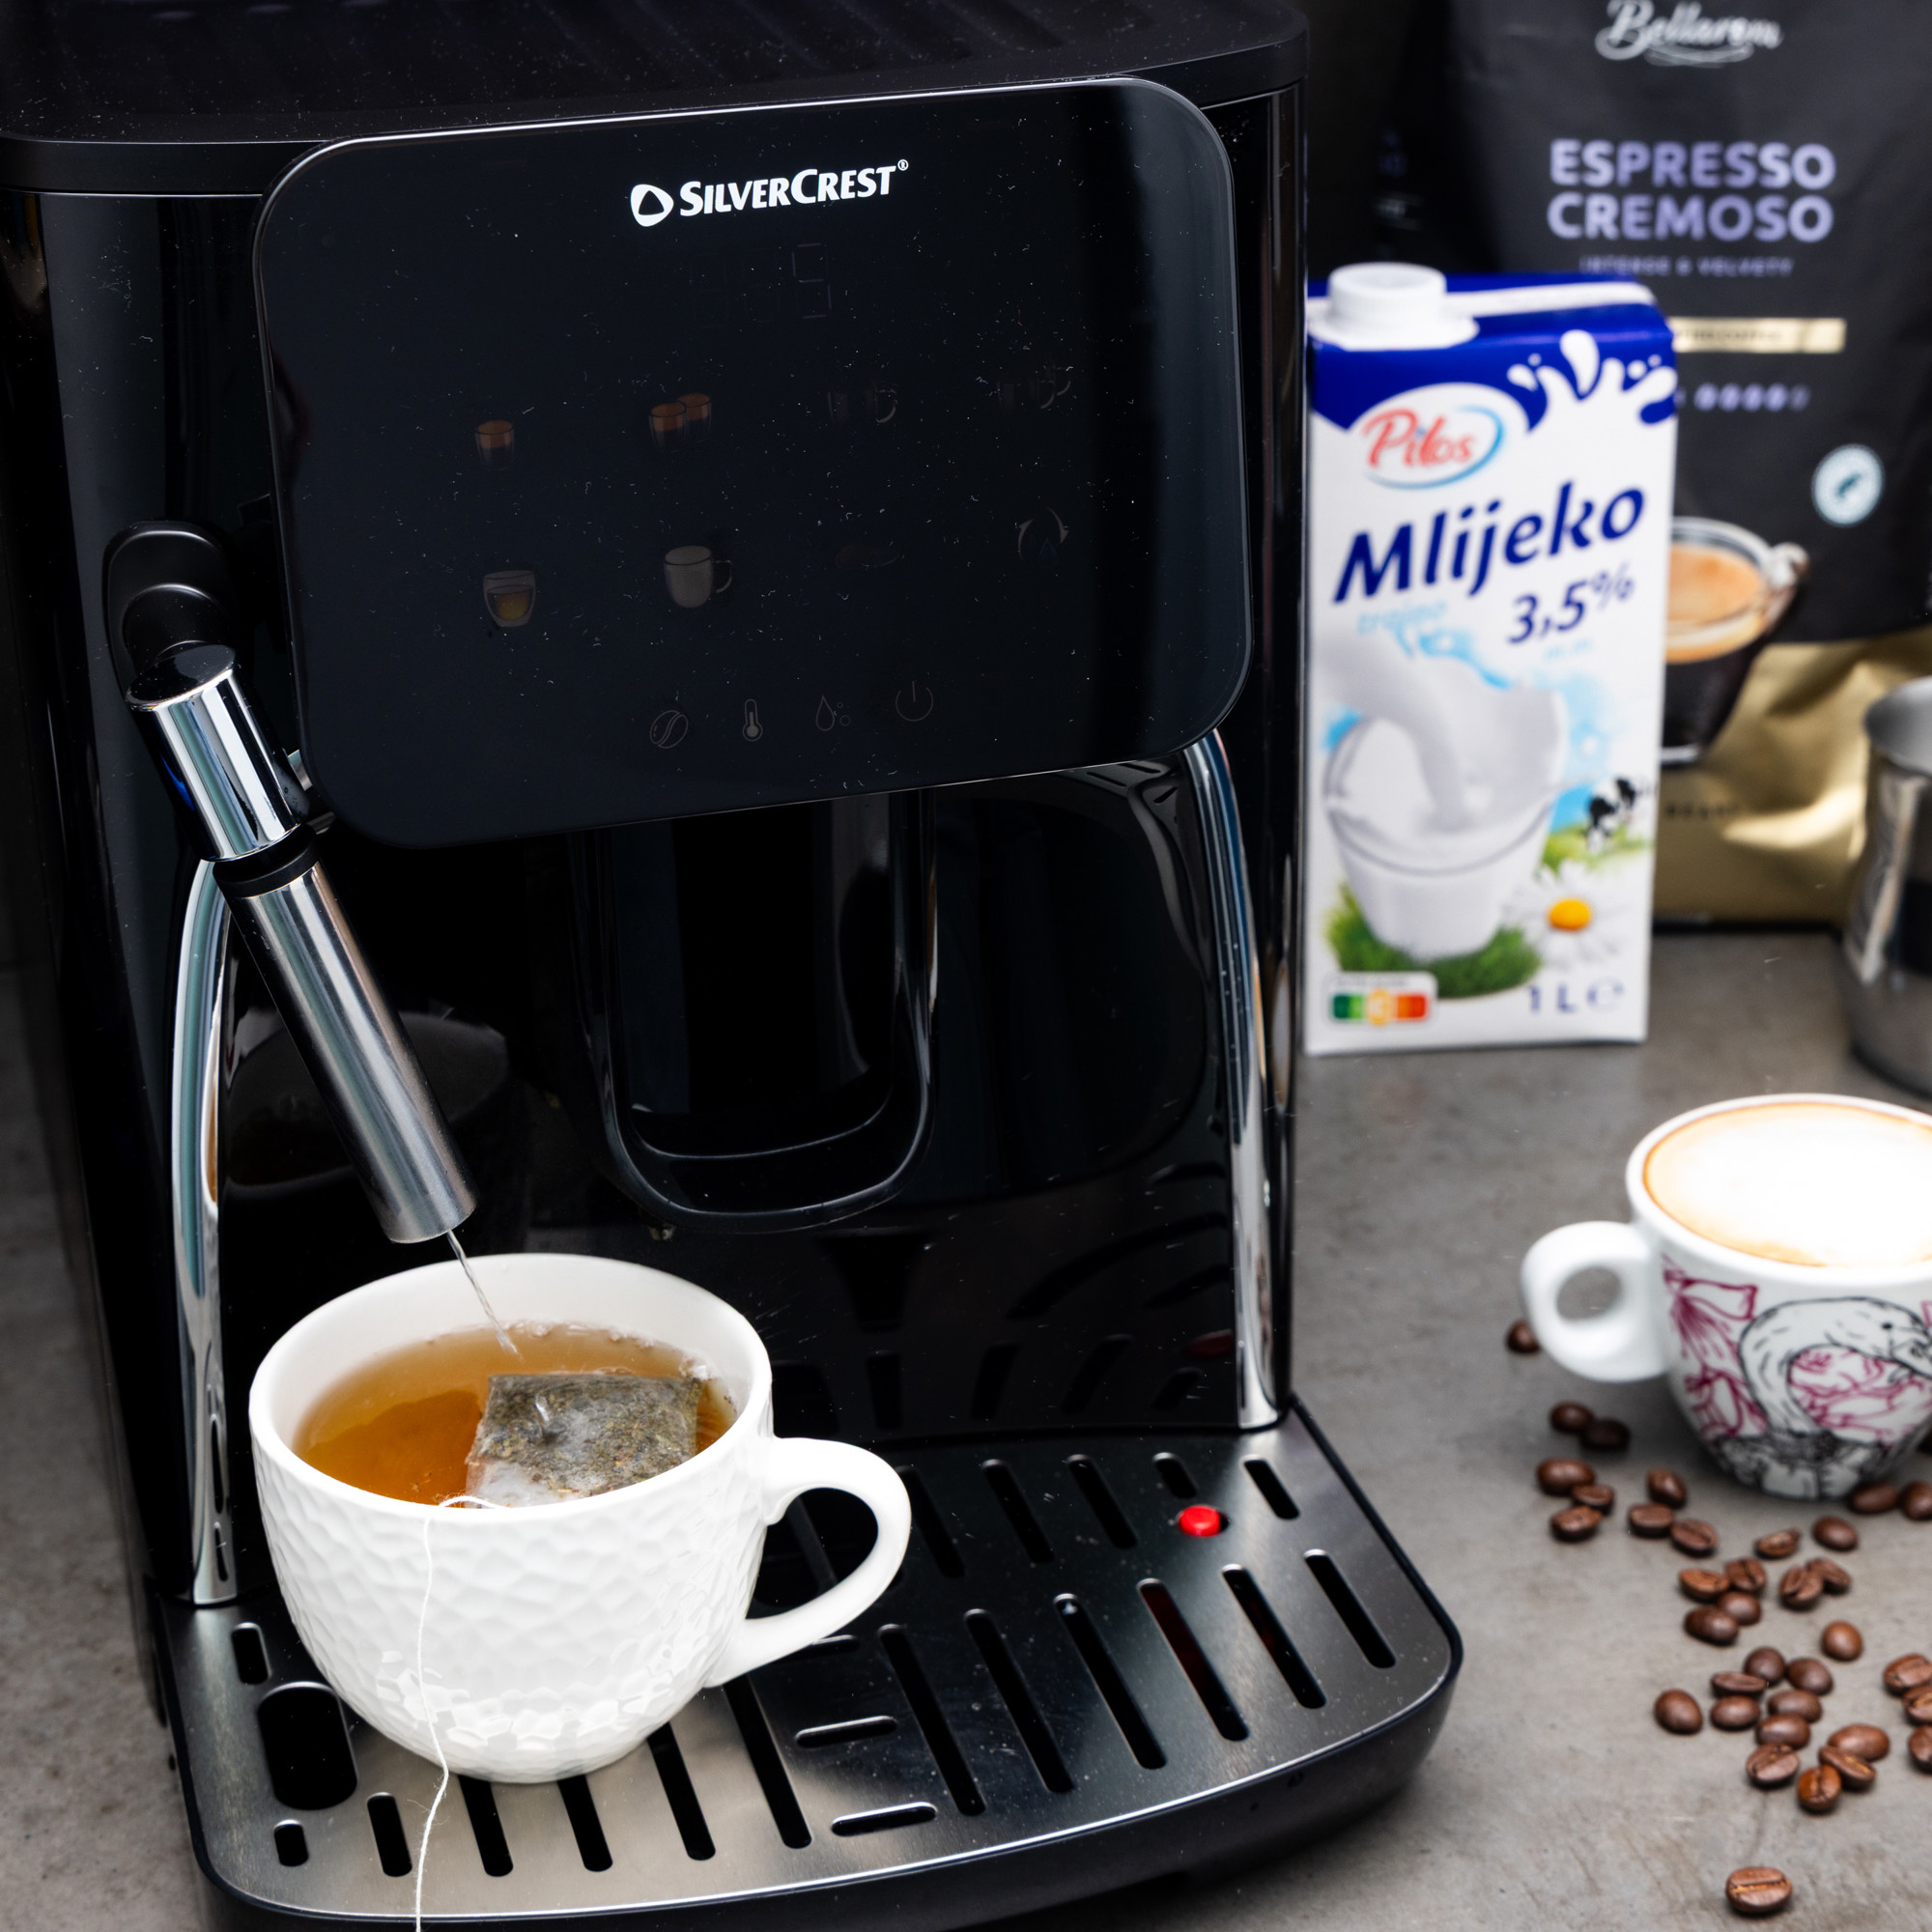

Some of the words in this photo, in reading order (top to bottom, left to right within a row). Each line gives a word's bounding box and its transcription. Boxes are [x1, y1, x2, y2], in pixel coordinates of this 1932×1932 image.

[1549, 138, 1836, 189] ESPRESSO
[1547, 192, 1834, 242] CREMOSO
[1362, 408, 1475, 469] Pilos
[1333, 479, 1646, 605] Mlijeko
[1507, 562, 1634, 644] 3,5%
